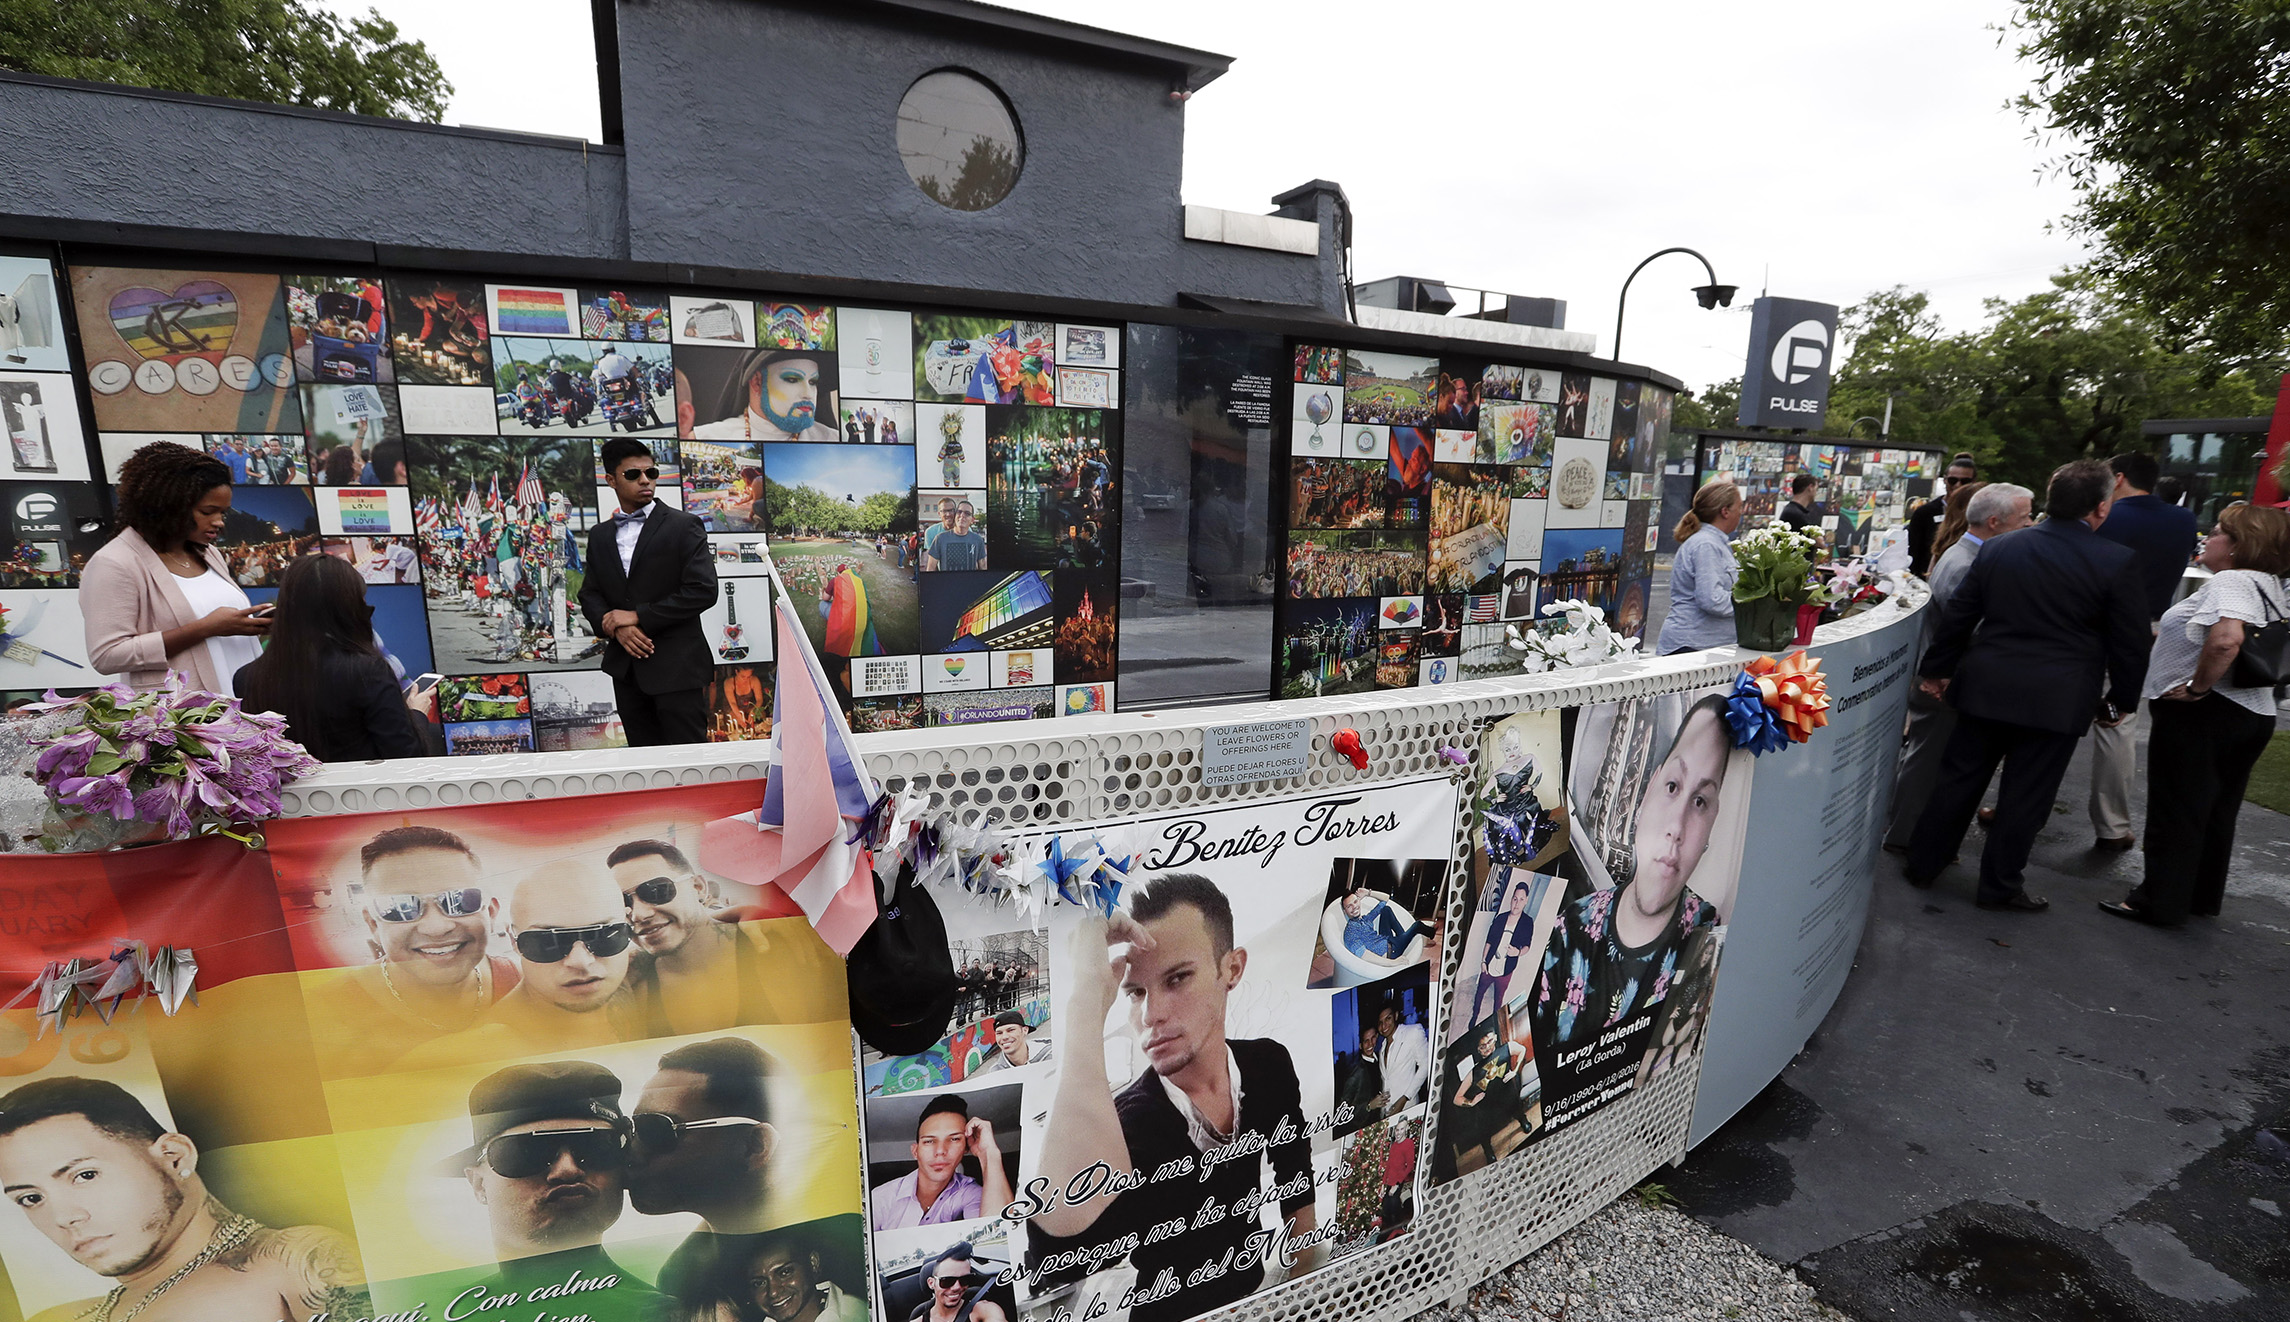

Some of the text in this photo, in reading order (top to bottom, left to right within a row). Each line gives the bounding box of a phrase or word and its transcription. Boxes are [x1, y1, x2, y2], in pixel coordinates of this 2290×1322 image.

[96, 355, 292, 390] CARES
[344, 392, 365, 402] LOVE
[1769, 397, 1818, 414] PULSE
[348, 404, 368, 414] HATE
[21, 524, 62, 532] PULSE
[1212, 721, 1305, 736] YOU ARE WELCOME TO
[1217, 731, 1299, 746] LEAVE FLOWERS OR
[1222, 742, 1293, 755] OFFERINGS HERE.
[1207, 764, 1235, 774] PUEDE
[1237, 761, 1264, 771] DEJAR
[1266, 759, 1296, 768] FLORES
[1207, 774, 1235, 784] OTRAS
[1237, 769, 1281, 781] OFRENDAS
[1142, 796, 1401, 871] Benitez Torres
[1556, 1015, 1651, 1069] Leroy Valentin
[1575, 1059, 1593, 1075] (La
[1594, 1041, 1627, 1065] Gorda)
[1001, 1100, 1355, 1222] Si Dios me quita la vista
[995, 1161, 1354, 1287] es porque me ha dejado ver
[1082, 1291, 1109, 1322] lo
[1116, 1266, 1182, 1311] bello
[1186, 1247, 1235, 1288] del
[1233, 1217, 1345, 1270] Mundo.
[444, 1285, 523, 1321] Con
[526, 1270, 625, 1303] calma
